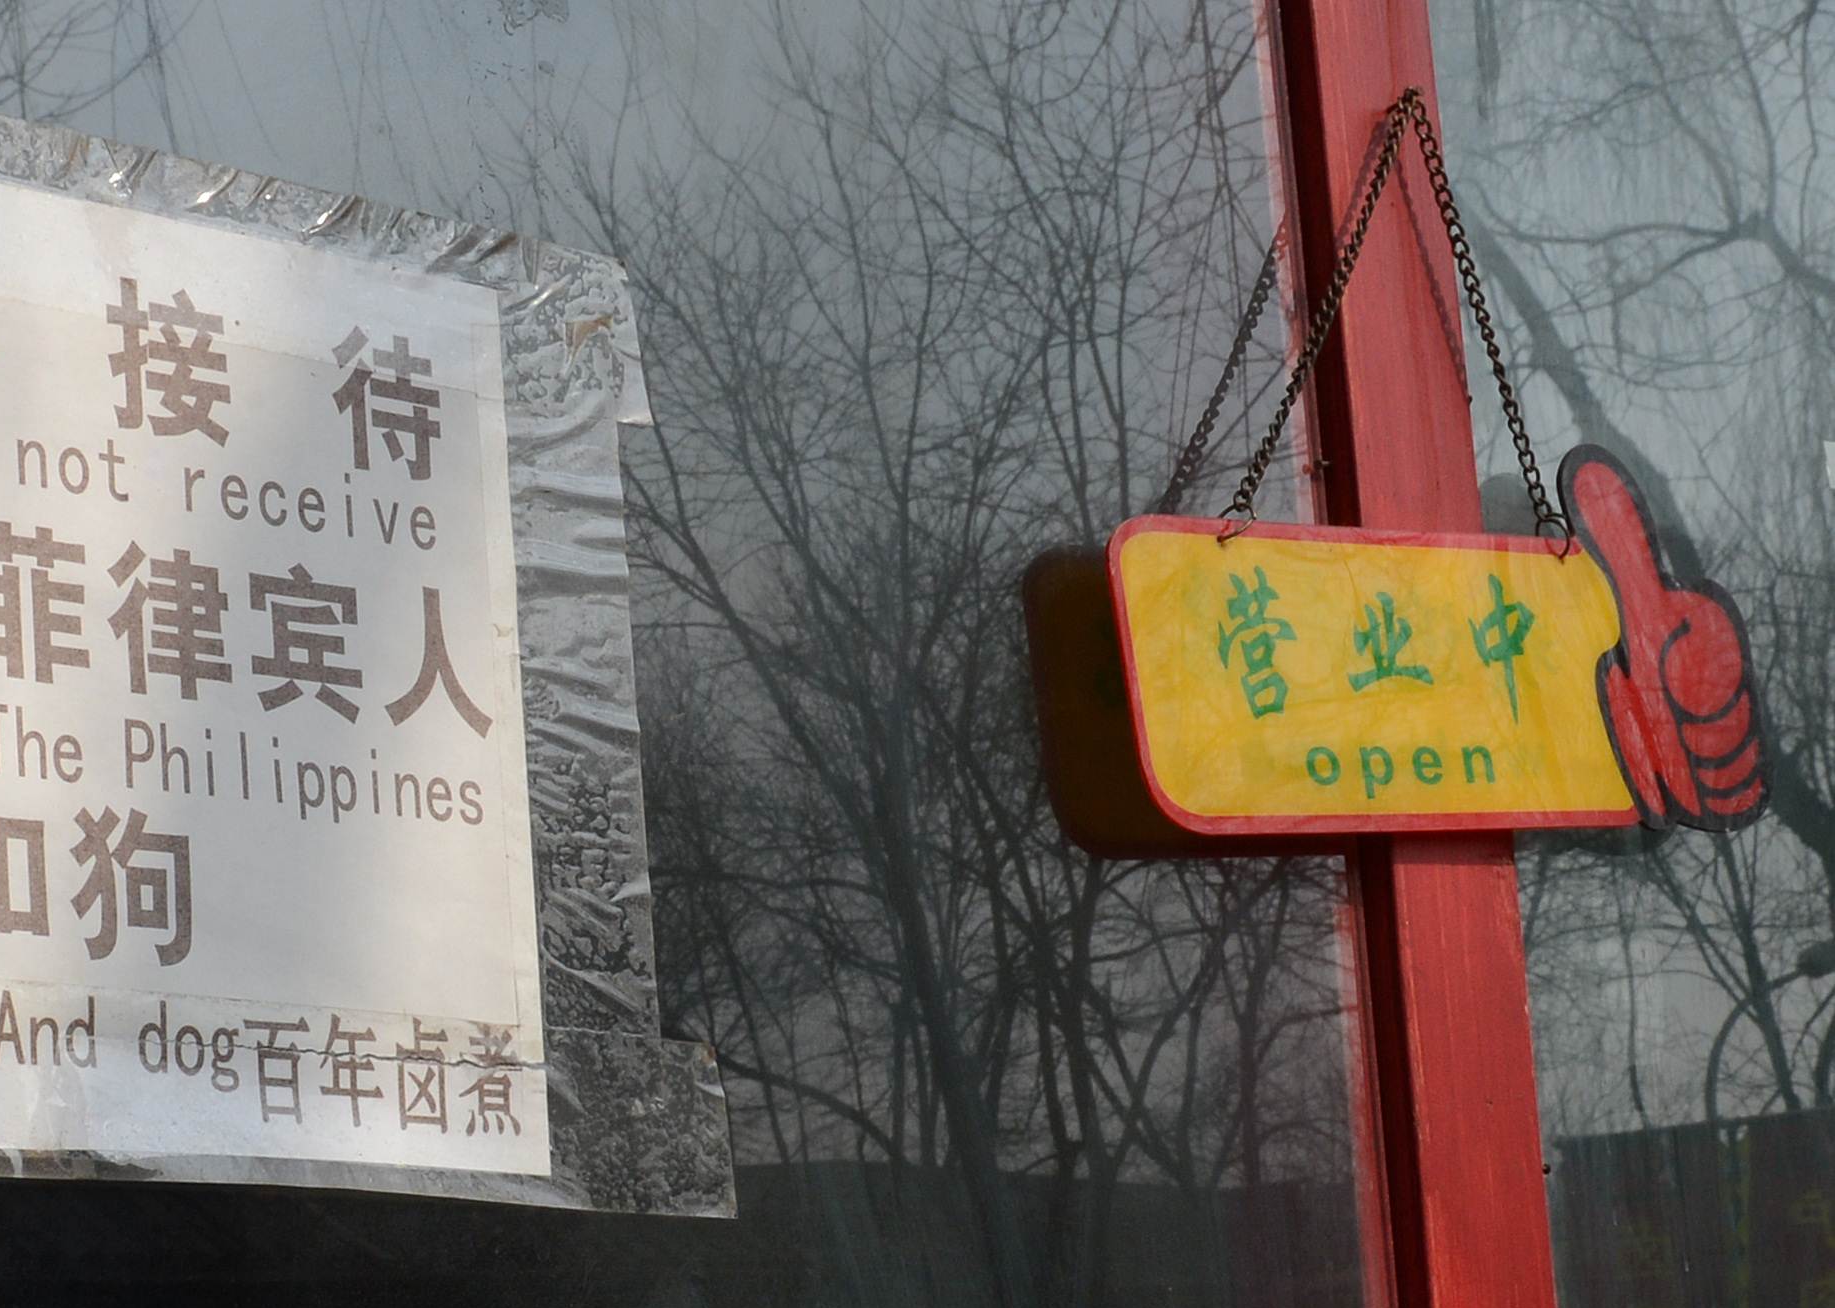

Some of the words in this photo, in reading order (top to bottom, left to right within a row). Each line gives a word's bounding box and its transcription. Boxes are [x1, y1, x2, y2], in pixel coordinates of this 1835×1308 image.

[17, 437, 129, 503] not
[184, 464, 437, 551] receive
[1218, 566, 1535, 724] 营业中
[124, 718, 484, 826] Philippines
[1306, 744, 1496, 799] open
[138, 1000, 240, 1091] dog
[243, 1013, 521, 1137] 百年卤煮
